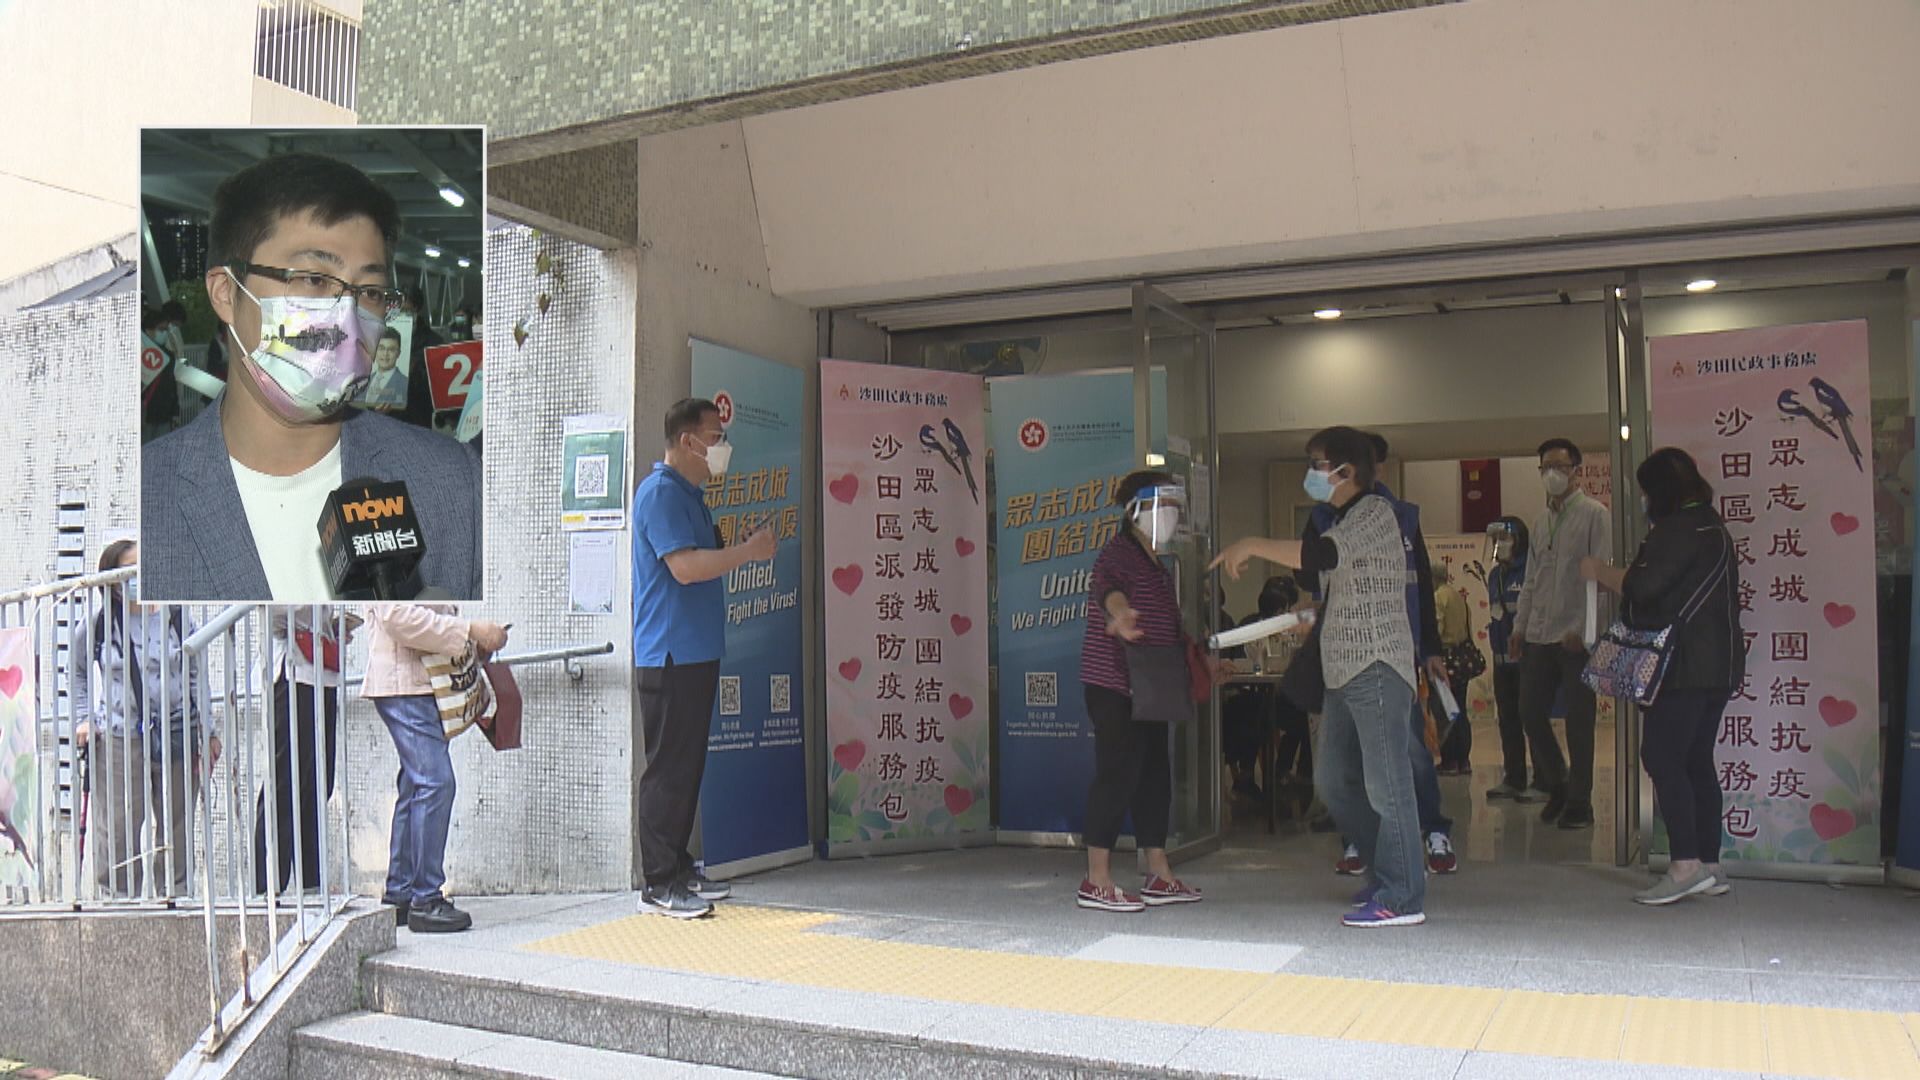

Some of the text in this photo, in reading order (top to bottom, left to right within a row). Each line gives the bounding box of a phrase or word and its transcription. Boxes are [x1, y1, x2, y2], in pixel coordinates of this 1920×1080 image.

[443, 353, 473, 396] 2
[1696, 351, 1818, 376] 沙田民政事務處
[703, 464, 790, 509] 眾志成城
[342, 495, 405, 524] now
[351, 527, 418, 557] 新聞台
[728, 558, 777, 594] United,
[727, 587, 797, 625] Fight the Virus!
[1011, 612, 1035, 631] We
[1038, 602, 1077, 628] Fight
[871, 434, 909, 822] 沙田區派發防疫服務包
